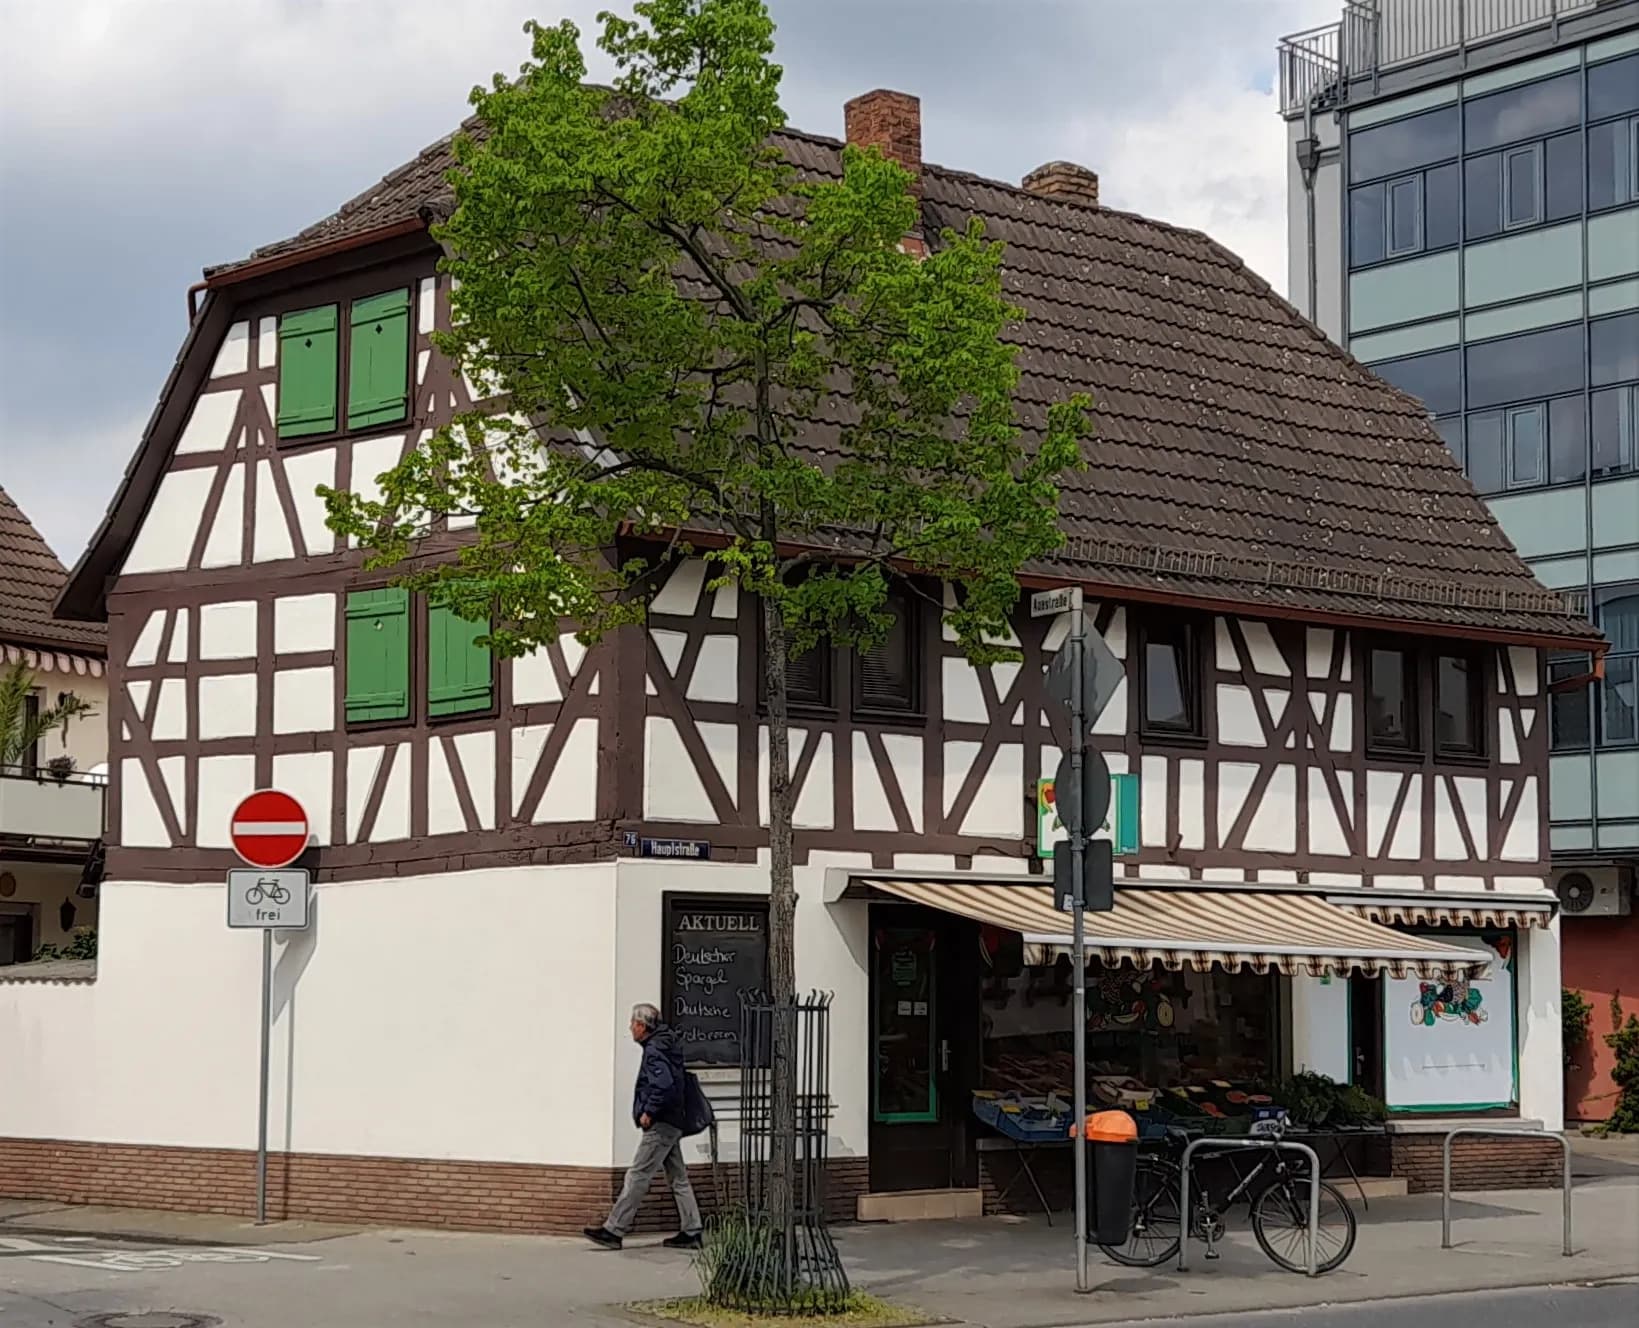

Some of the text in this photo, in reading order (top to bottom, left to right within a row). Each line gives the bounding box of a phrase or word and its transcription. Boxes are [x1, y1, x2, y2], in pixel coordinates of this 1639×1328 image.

[650, 840, 700, 857] Hauptstraße
[255, 908, 281, 921] frei
[679, 914, 760, 931] AKTUELL
[672, 943, 737, 965] Deutscher
[675, 966, 729, 995] Spargel
[674, 996, 732, 1018] Deutsche
